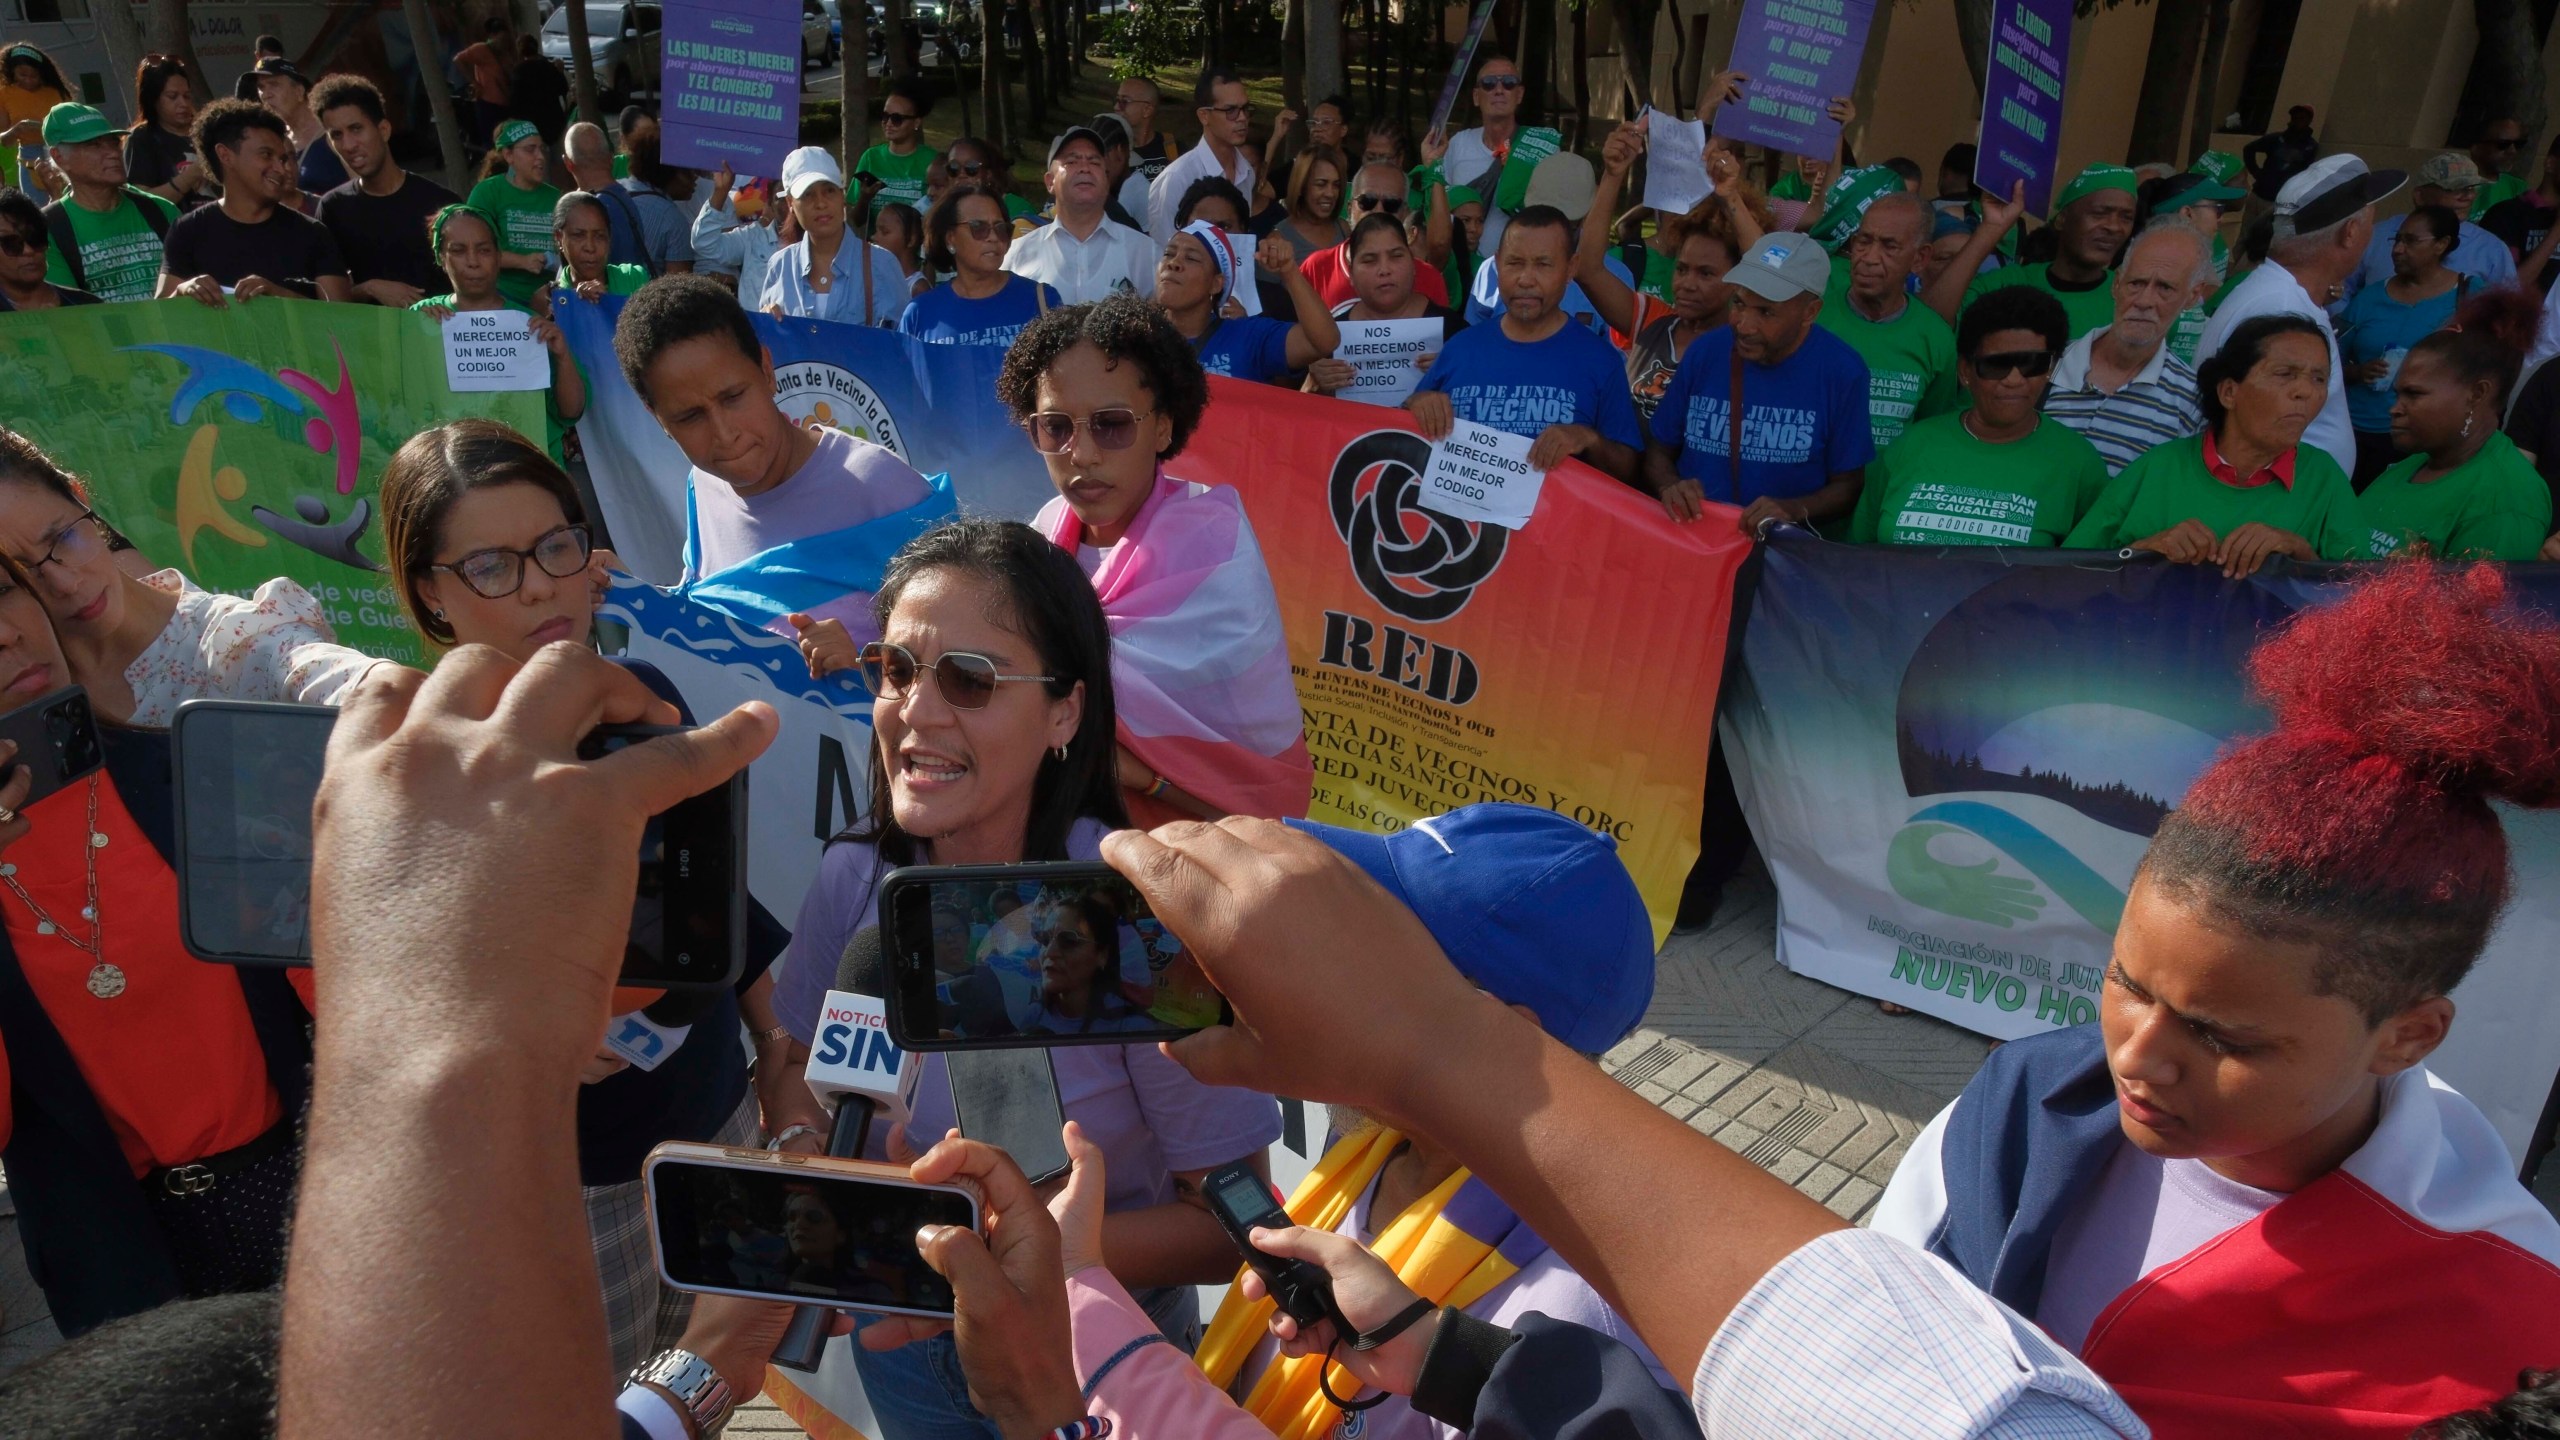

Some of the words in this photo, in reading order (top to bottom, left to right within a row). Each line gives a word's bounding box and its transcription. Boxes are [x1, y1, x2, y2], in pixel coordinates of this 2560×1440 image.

[1765, 1, 1779, 17] UN
[1780, 3, 1819, 27] CÓDIGO
[1818, 13, 1848, 36] PENAL
[2016, 2, 2025, 28] EL
[2023, 9, 2051, 49] ABORTO
[1763, 20, 1793, 34] para
[1795, 25, 1812, 39] RD
[1812, 32, 1843, 47] pero
[667, 39, 689, 57] LAS
[692, 43, 746, 65] MUJERES
[748, 51, 795, 72] MUEREN
[1768, 36, 1785, 53] NO
[1788, 41, 1811, 60] UNO
[1810, 46, 1833, 66] QUE
[2001, 18, 2039, 59] inseguro
[2039, 50, 2061, 79] mata,
[665, 58, 688, 69] por
[690, 60, 736, 76] abortos
[738, 66, 796, 85] inseguros
[1766, 62, 1819, 88] PROMUEVA
[1996, 41, 2021, 76] ABORTO
[2019, 60, 2029, 81] EN
[2028, 64, 2034, 83] 3
[2032, 68, 2061, 102] CAUSALES
[688, 73, 697, 88] Y
[697, 74, 710, 90] EL
[712, 76, 774, 99] CONGRESO
[1751, 79, 1761, 92] la
[1763, 84, 1818, 105] agresión
[1817, 98, 1826, 108] a
[2016, 82, 2038, 106] para
[677, 93, 698, 110] LES
[700, 95, 716, 111] DA
[717, 97, 731, 114] LA
[733, 100, 783, 121] ESPALDA
[1748, 95, 1778, 117] NIÑOS
[1779, 103, 1789, 118] Y
[1786, 104, 1818, 126] NIÑAS
[2001, 96, 2026, 133] SALVAR
[2025, 111, 2047, 143] VIDAS
[471, 317, 496, 327] NOS
[1365, 327, 1391, 338] NOS
[453, 331, 530, 342] MERECEMOS
[959, 330, 978, 343] DE
[1344, 342, 1426, 355] MERECEMOS
[455, 348, 472, 357] UN
[476, 348, 517, 357] MEJOR
[1366, 359, 1410, 370] MEJOR
[457, 362, 505, 372] CODIGO
[805, 367, 822, 386] de
[826, 370, 867, 407] Vecino
[865, 399, 879, 422] la
[1451, 385, 1481, 399] RED
[1490, 385, 1507, 397] DE
[1511, 386, 1577, 404] JUNTAS
[1689, 395, 1718, 413] RED
[1747, 405, 1816, 425] JUNTAS
[1469, 431, 1498, 448] NOS
[1745, 446, 1810, 457] TERRITORIALES
[1444, 441, 1528, 475] MERECEMOS
[1741, 454, 1767, 463] SANTO
[1769, 455, 1809, 463] DOMINGO
[1438, 460, 1457, 474] UN
[1459, 466, 1505, 488] MEJOR
[1434, 476, 1485, 501] CODIGO
[1909, 492, 2034, 517] #LASCAUSALESVAN
[1898, 513, 1910, 525] EN
[1917, 515, 1929, 526] EL
[1938, 517, 1983, 534] CÓDIGO
[1991, 524, 2029, 541] PENAL
[2371, 528, 2398, 548] VAN
[2370, 542, 2390, 557] AN
[308, 581, 340, 602] de
[323, 605, 353, 625] de
[1319, 611, 1479, 705] RED
[1291, 665, 1309, 678] DE
[1313, 670, 1369, 691] JUNTAS
[1372, 683, 1390, 698] DE
[1394, 690, 1451, 721] VECINOS
[1454, 715, 1464, 726] Y
[1467, 720, 1496, 738] OCB
[1329, 685, 1339, 693] LA
[1342, 687, 1392, 710] PROVINCIA
[1392, 704, 1420, 721] SANTO
[1421, 716, 1461, 737] DOMINGO
[1335, 698, 1366, 713] Social,
[1369, 708, 1409, 729] Inclusión
[1412, 724, 1418, 732] y
[1302, 708, 1359, 738] NTA
[1369, 726, 1405, 755] DE
[1415, 743, 1537, 803] VECINOS
[1547, 790, 1568, 812] Y
[1303, 728, 1382, 765] VINCIA
[1390, 756, 1470, 799] SANTO
[1335, 795, 1369, 820] LAS
[680, 849, 690, 877] 00:41
[1867, 915, 2013, 970] ASOCIACIÓN
[2020, 954, 2051, 981] DE
[1890, 946, 2027, 1012] NUEVO
[815, 1023, 902, 1076] SIN
[1219, 1170, 1241, 1185] SONY
